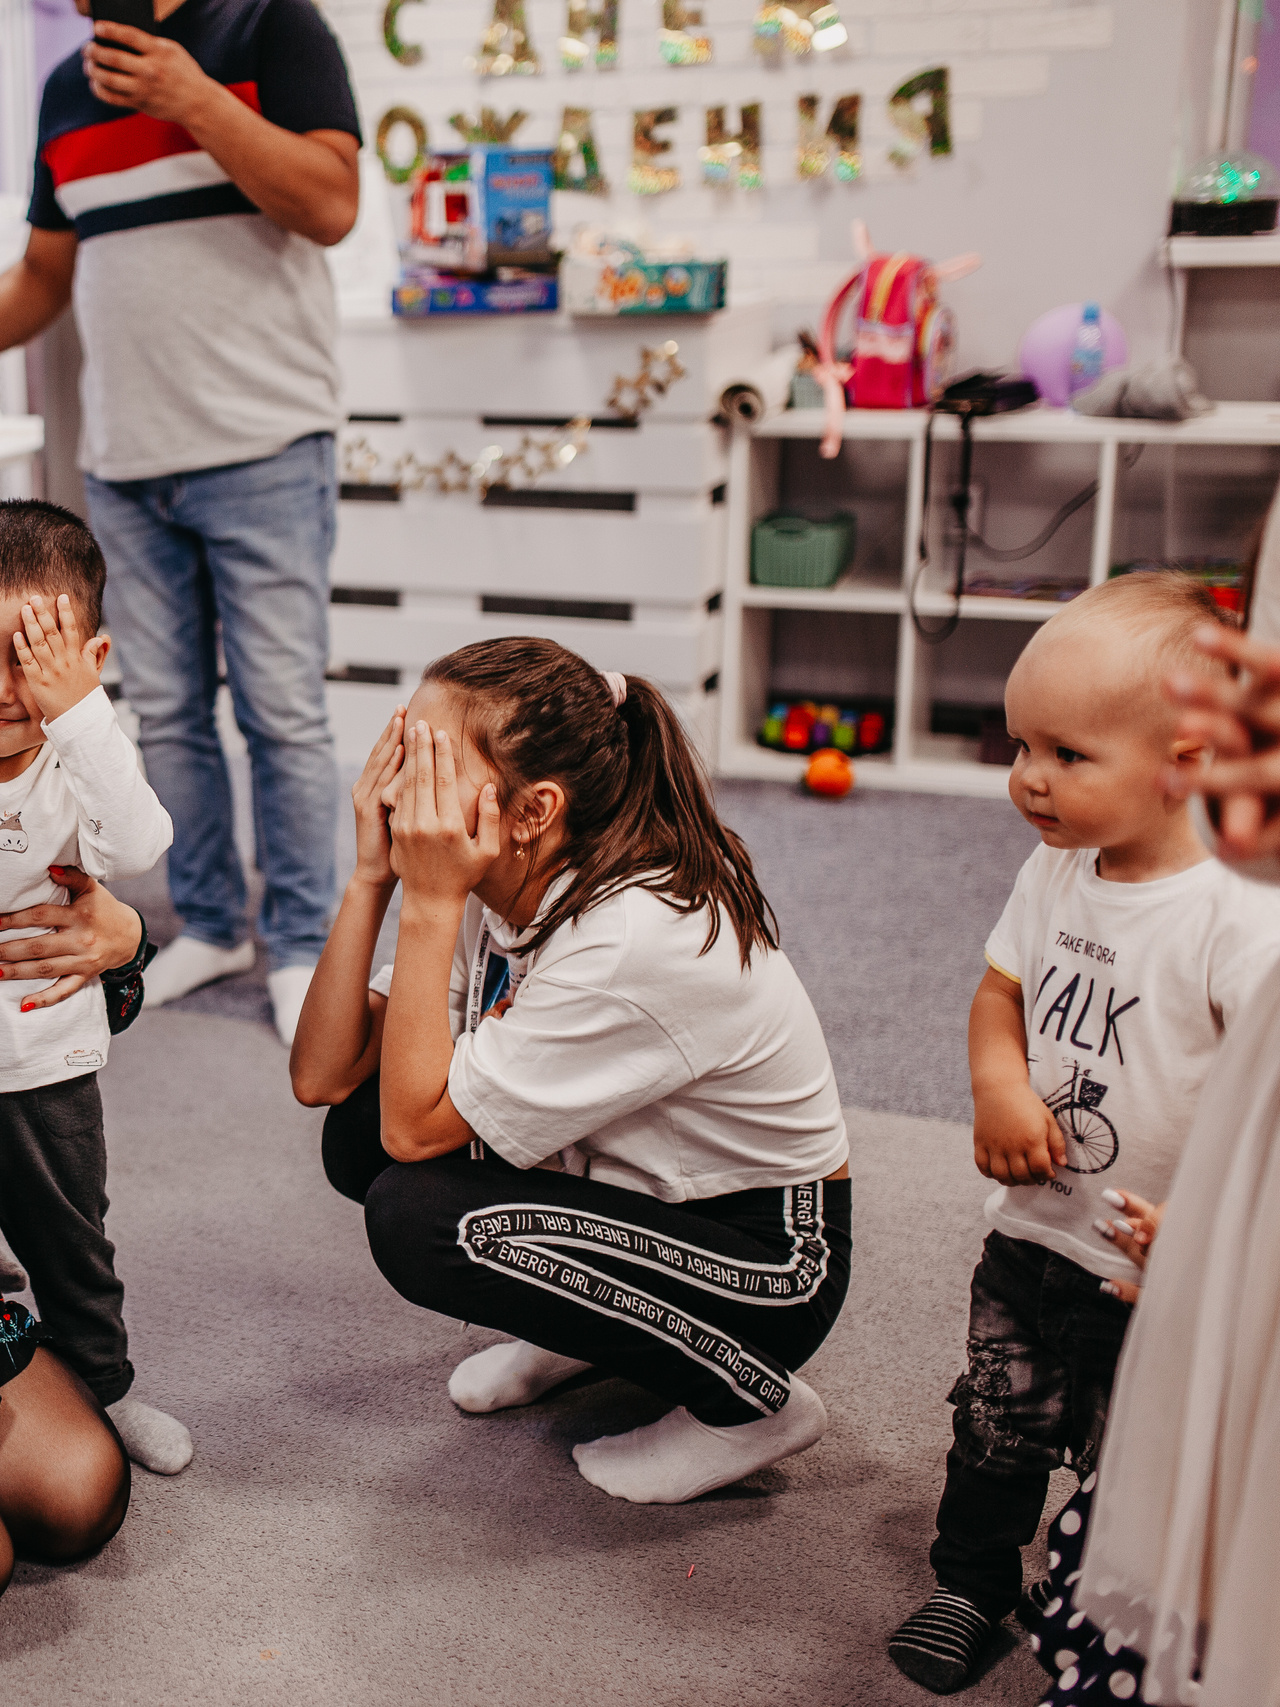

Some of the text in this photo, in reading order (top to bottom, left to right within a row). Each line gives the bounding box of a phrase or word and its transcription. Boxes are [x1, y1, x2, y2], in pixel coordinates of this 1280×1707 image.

[377, 66, 953, 195] ОЖДЕНИЯ
[1055, 931, 1084, 954] TAKE
[1035, 965, 1140, 1066] ALK
[1050, 1180, 1073, 1196] YOU
[535, 1213, 572, 1232] GIRL
[576, 1218, 631, 1248] ENERGY
[651, 1240, 683, 1267] GIRL
[687, 1255, 740, 1288] ENERGY
[498, 1243, 559, 1278] ENERGY
[560, 1268, 591, 1294] GIRL
[613, 1291, 665, 1323] ENERGY
[666, 1314, 693, 1344] GIRL
[759, 1380, 786, 1409] GIRL
